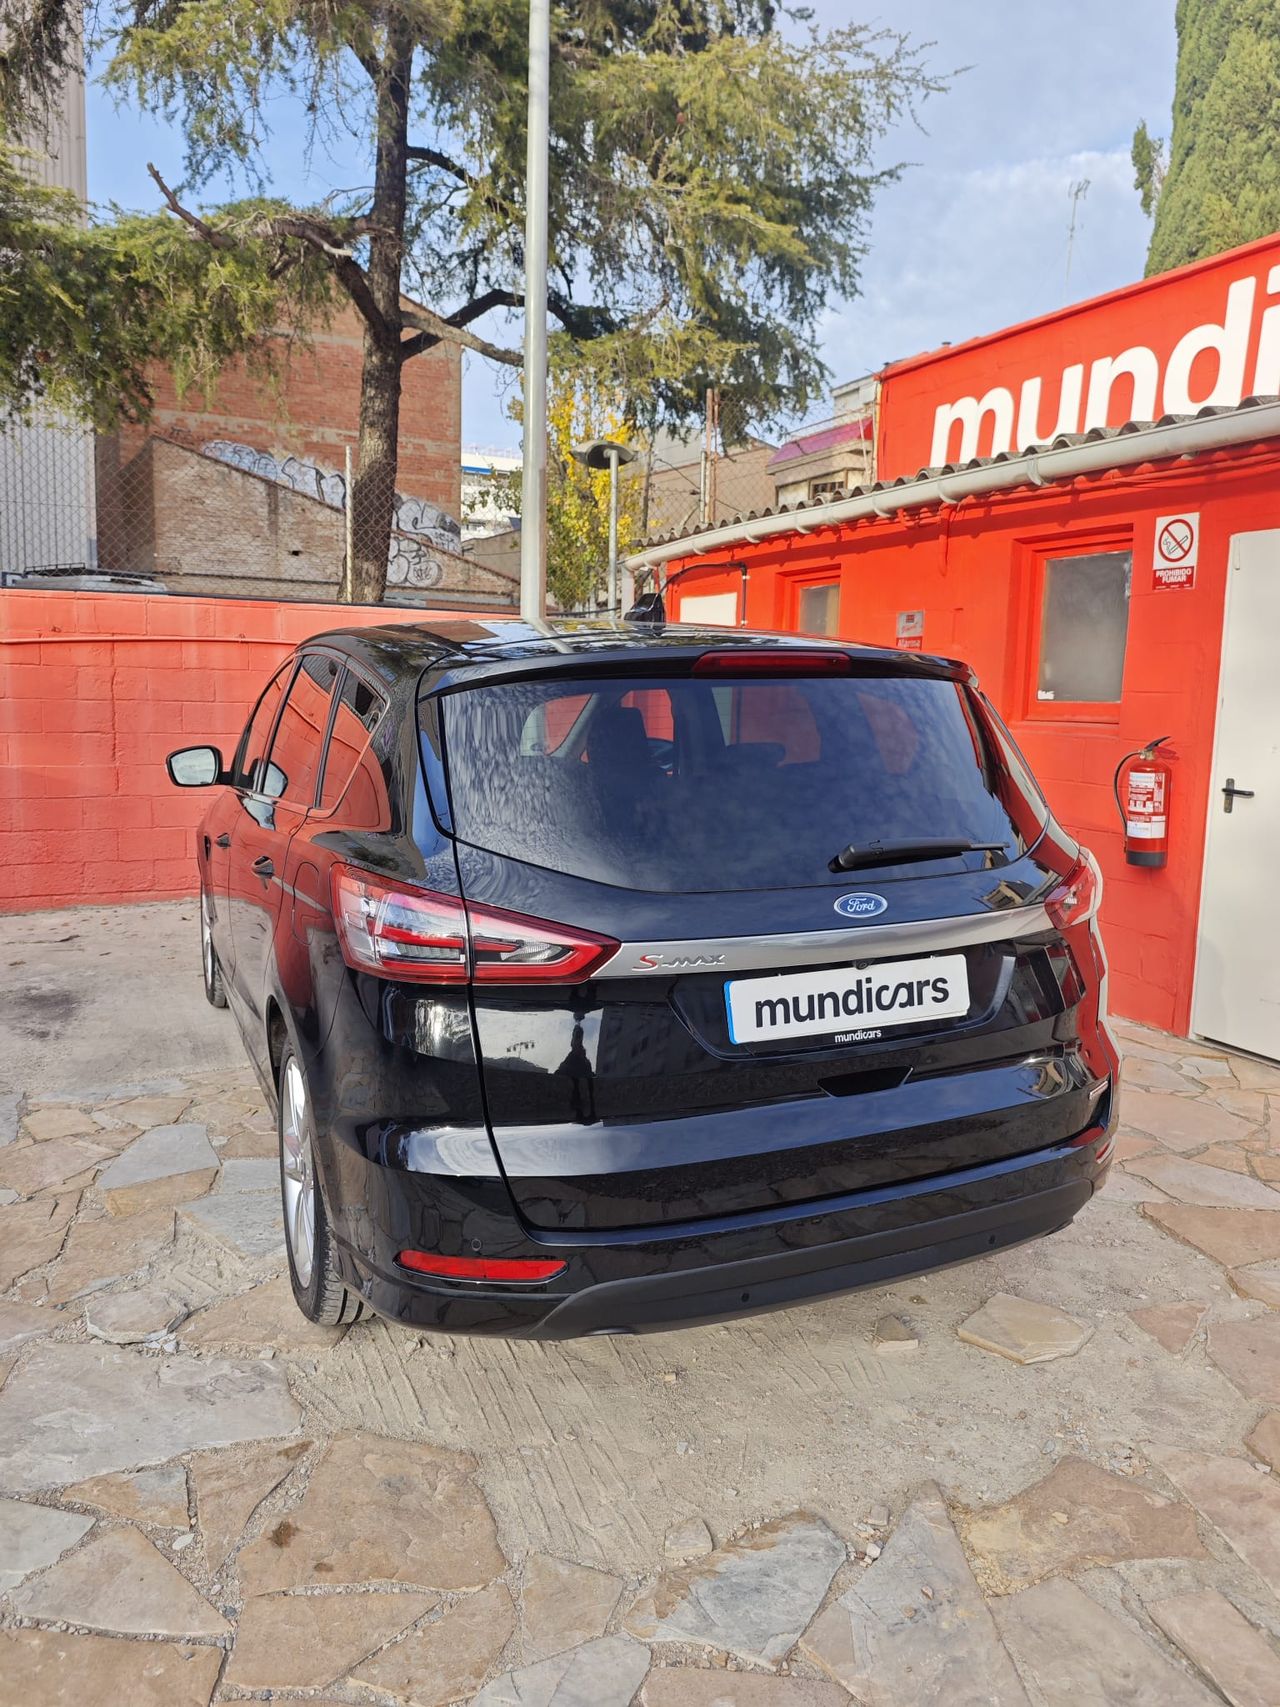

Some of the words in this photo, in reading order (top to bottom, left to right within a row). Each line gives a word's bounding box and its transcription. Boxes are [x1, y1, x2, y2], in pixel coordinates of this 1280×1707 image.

[1155, 568, 1192, 578] PROHIBIDO
[1161, 575, 1187, 584] FUMAR
[847, 897, 876, 912] Ford
[755, 976, 950, 1027] mundicars
[834, 1029, 882, 1043] mundicars
